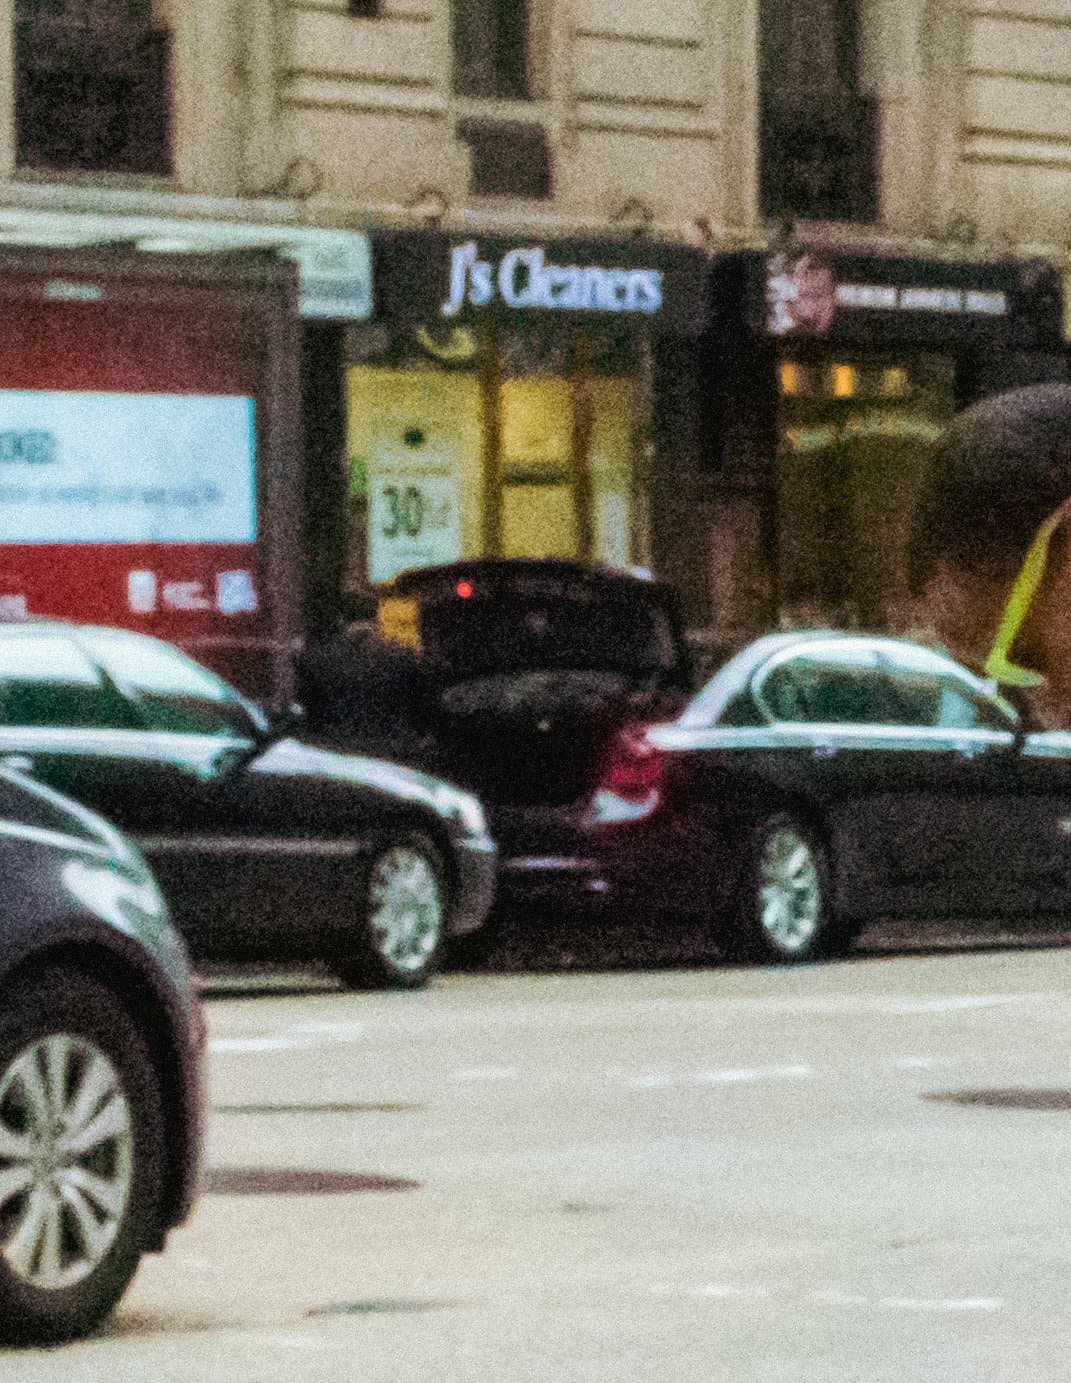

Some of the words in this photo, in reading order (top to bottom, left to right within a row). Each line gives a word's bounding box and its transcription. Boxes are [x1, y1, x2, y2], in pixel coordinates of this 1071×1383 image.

[442, 240, 493, 316] J's
[497, 244, 664, 315] Cleaners
[382, 485, 423, 540] 30
